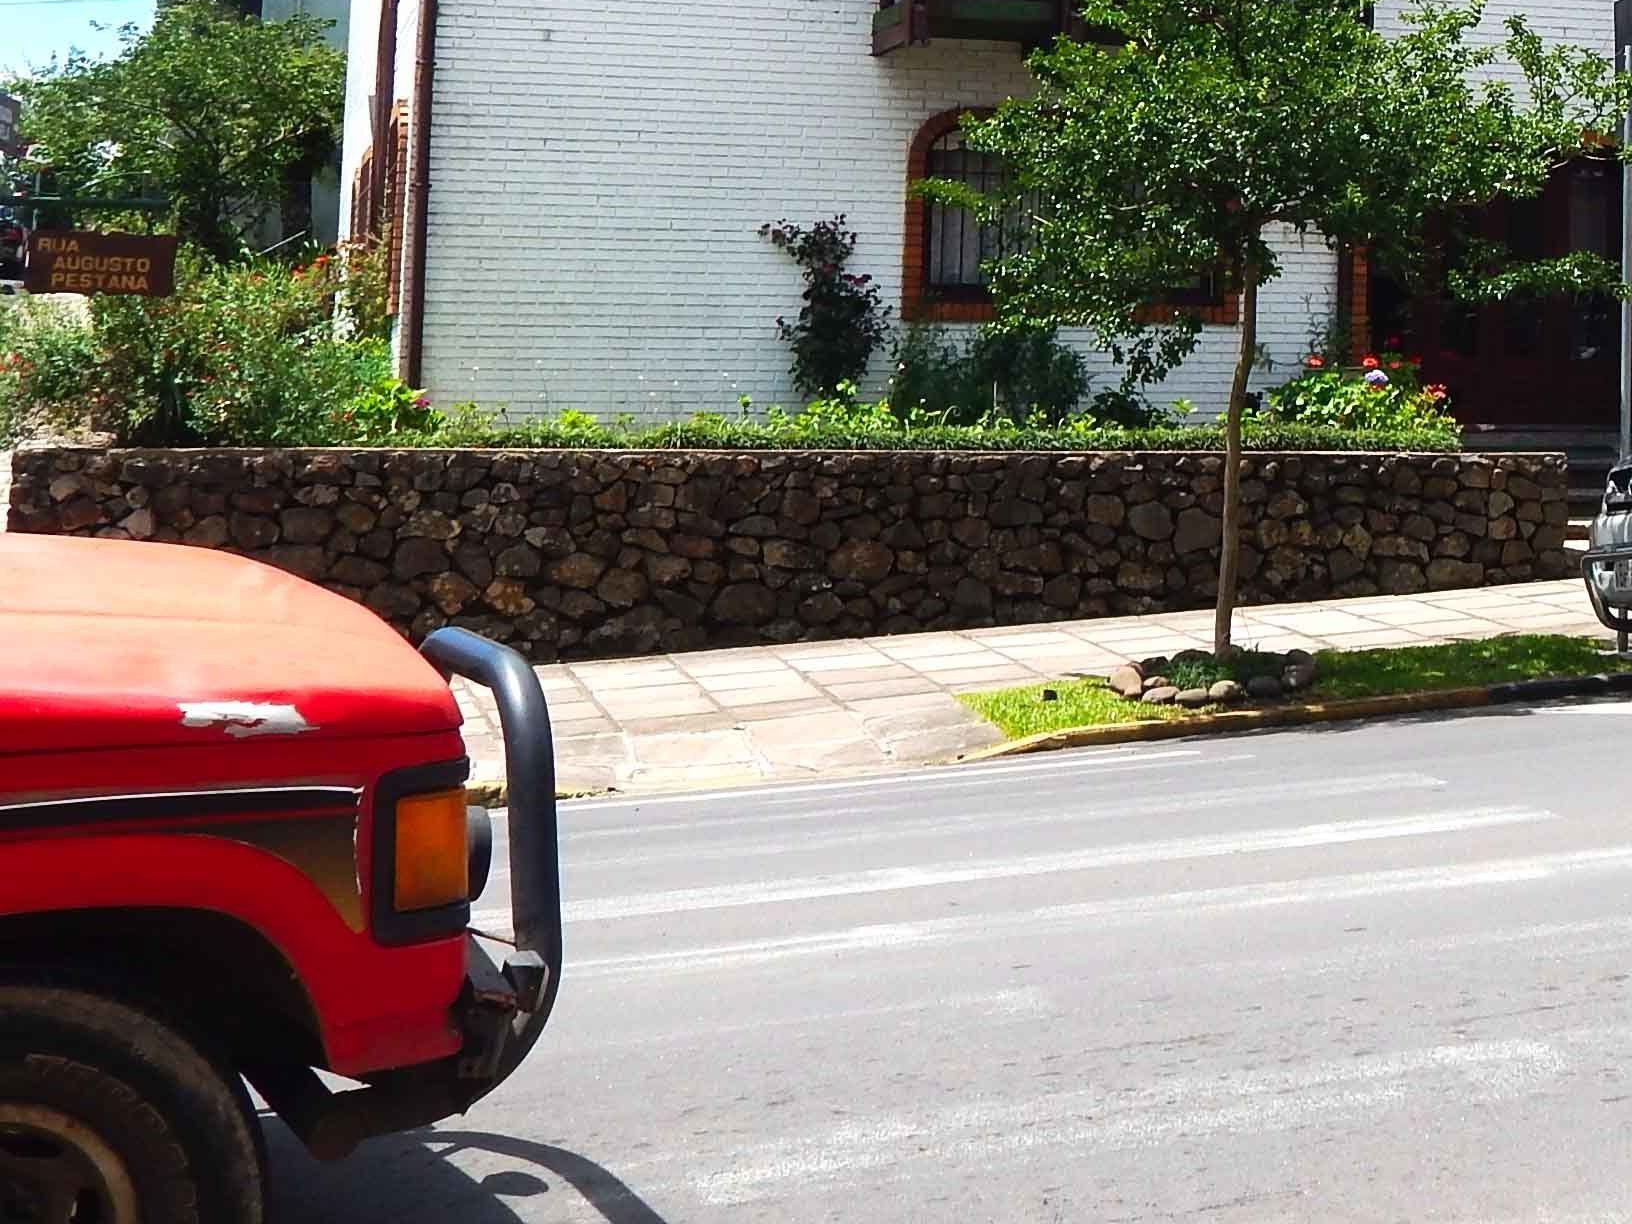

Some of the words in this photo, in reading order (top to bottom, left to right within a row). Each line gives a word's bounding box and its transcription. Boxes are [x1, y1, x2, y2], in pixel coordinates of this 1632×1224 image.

[37, 237, 80, 252] RUA
[53, 256, 150, 273] AUGUSTO
[51, 274, 149, 291] PESTANA
